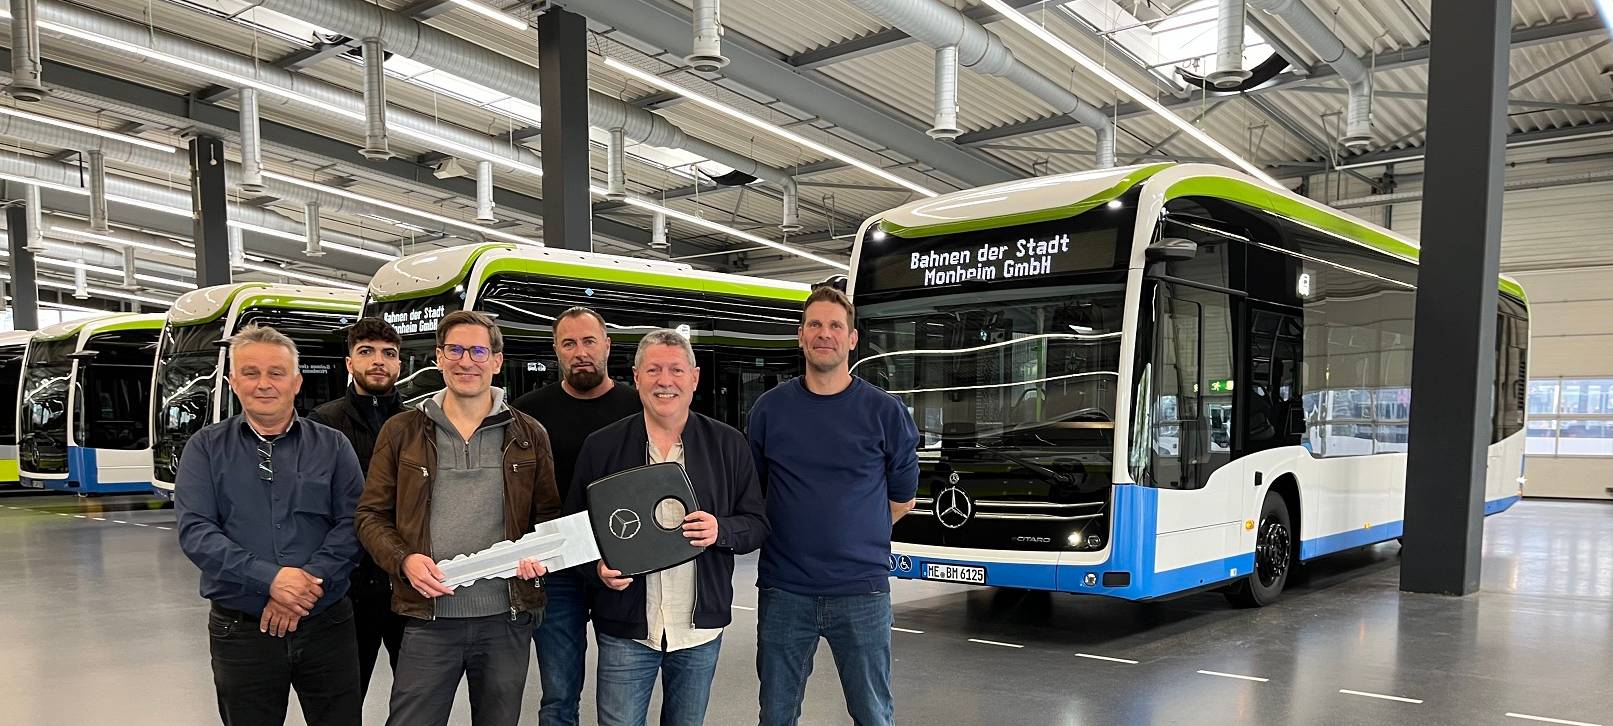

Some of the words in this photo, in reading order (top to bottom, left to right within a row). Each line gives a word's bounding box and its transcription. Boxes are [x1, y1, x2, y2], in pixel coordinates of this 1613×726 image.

[911, 250, 970, 269] Bahnen
[977, 244, 1008, 262] der
[1016, 234, 1070, 257] Stadt
[924, 264, 996, 286] Monheim
[1003, 256, 1051, 278] GmbH
[410, 308, 422, 320] der
[424, 305, 445, 319] Stadt
[391, 322, 417, 334] onheim
[419, 319, 438, 332] GmbH
[928, 565, 940, 578] ME
[946, 567, 958, 579] BM
[960, 568, 984, 581] 6125
